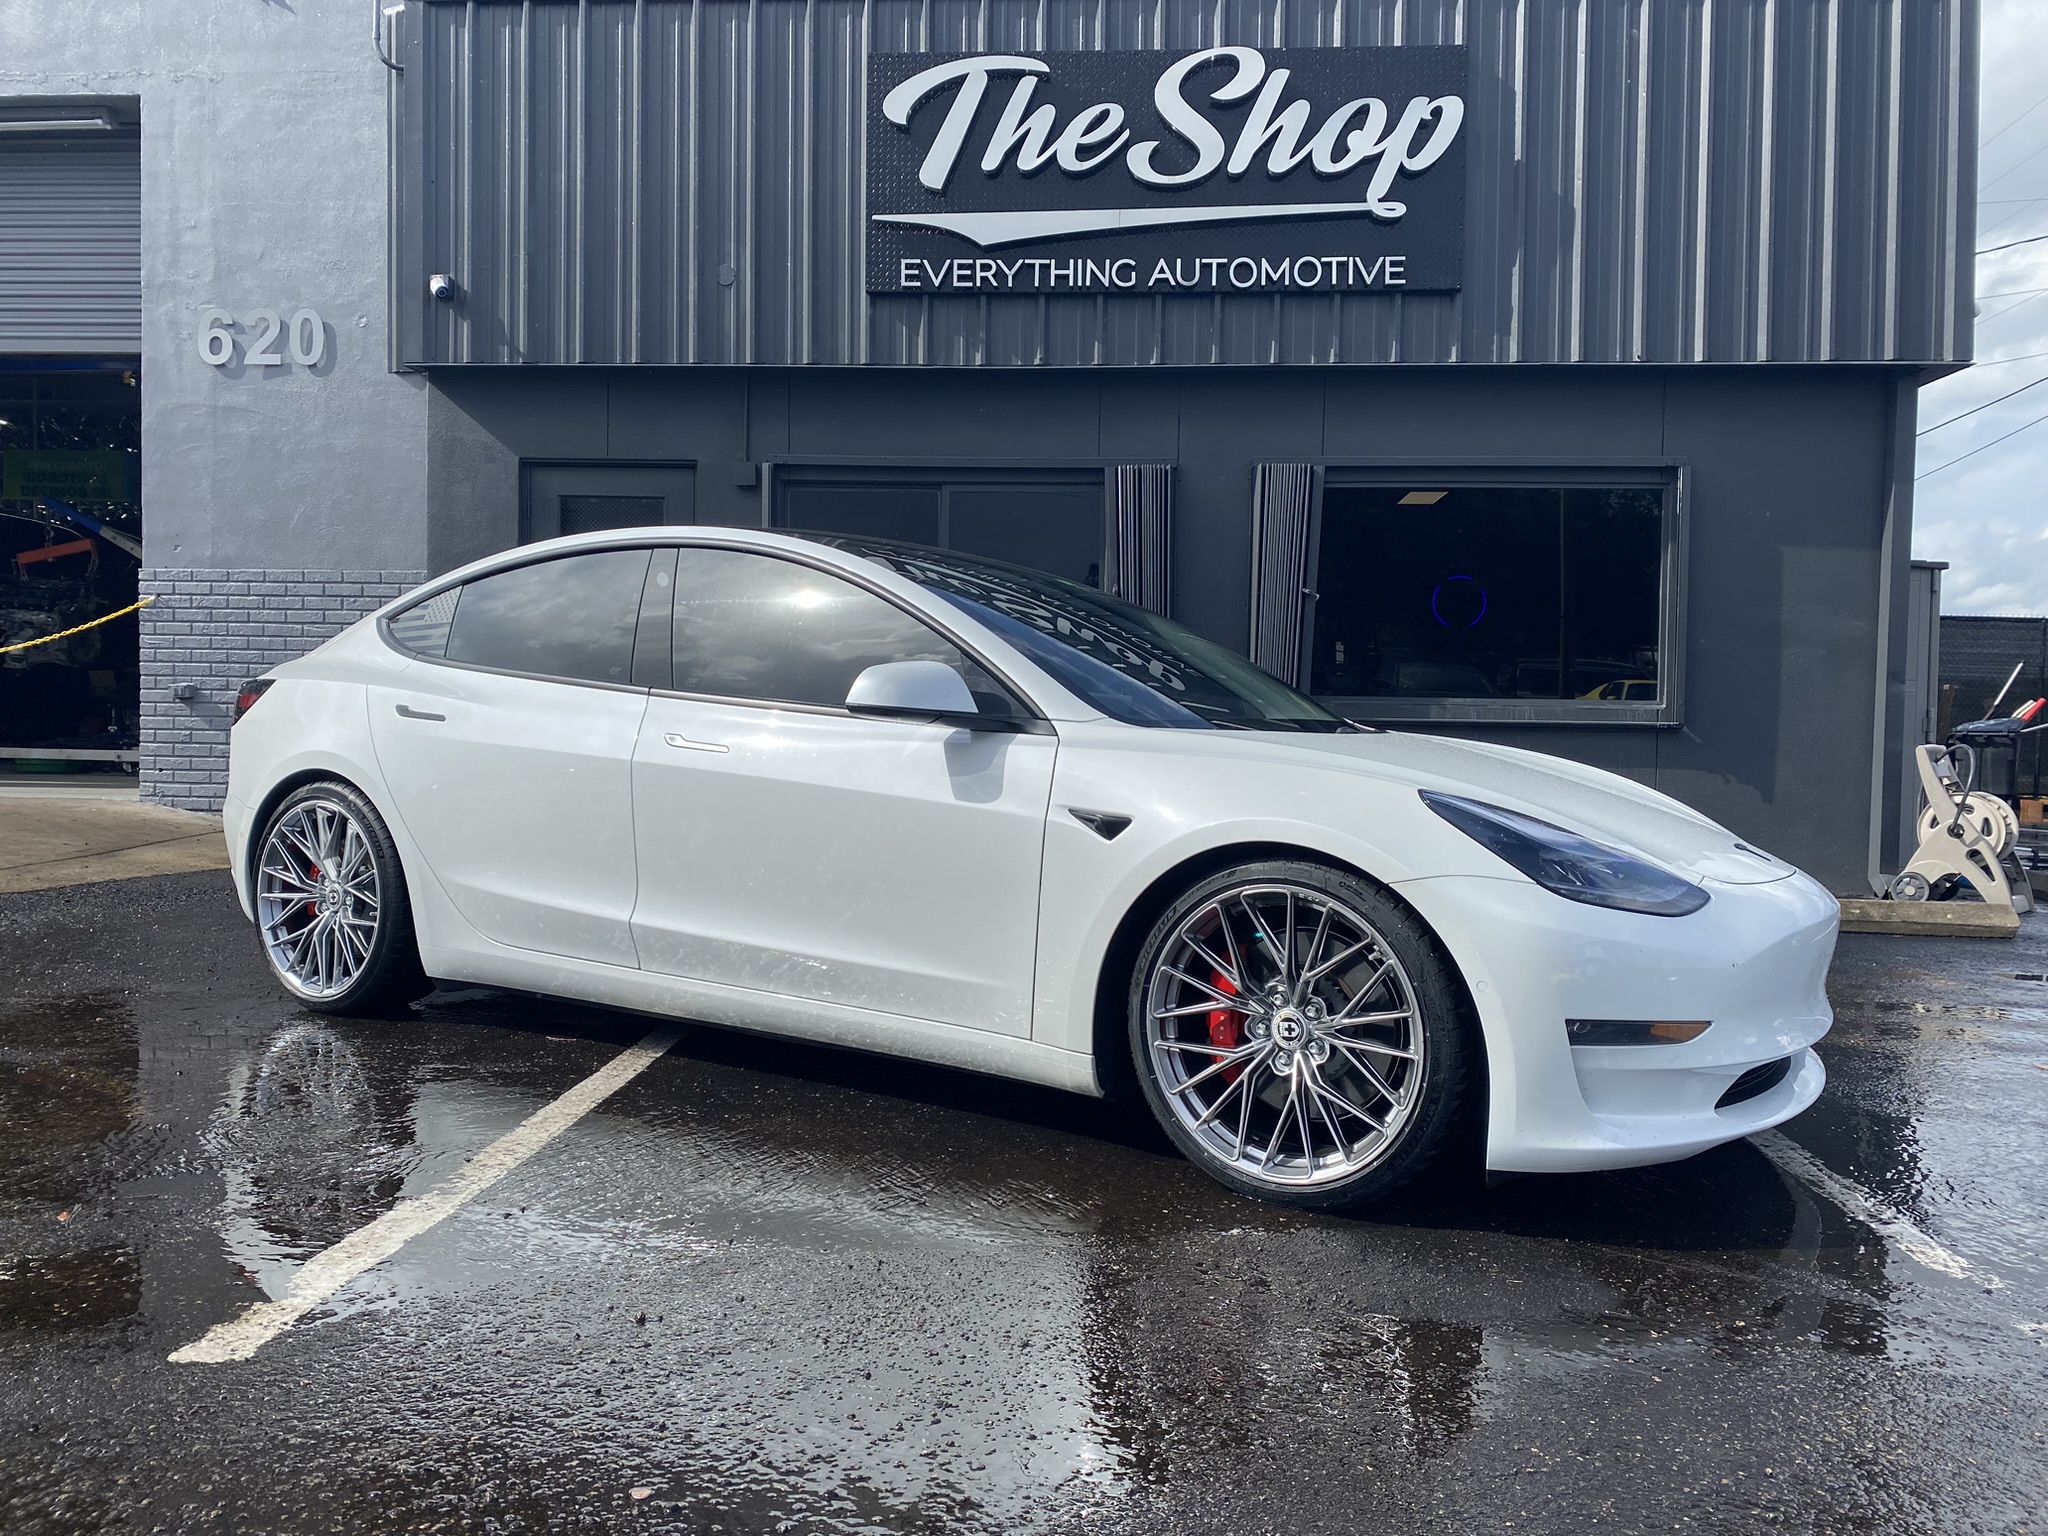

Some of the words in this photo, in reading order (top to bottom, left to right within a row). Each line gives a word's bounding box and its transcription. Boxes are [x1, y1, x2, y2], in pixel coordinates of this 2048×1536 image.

[900, 257, 1136, 288] EVERYTHING
[1148, 255, 1406, 287] AUTOMOTIVE
[197, 308, 325, 366] 620
[1140, 904, 1177, 968] MICHELIN
